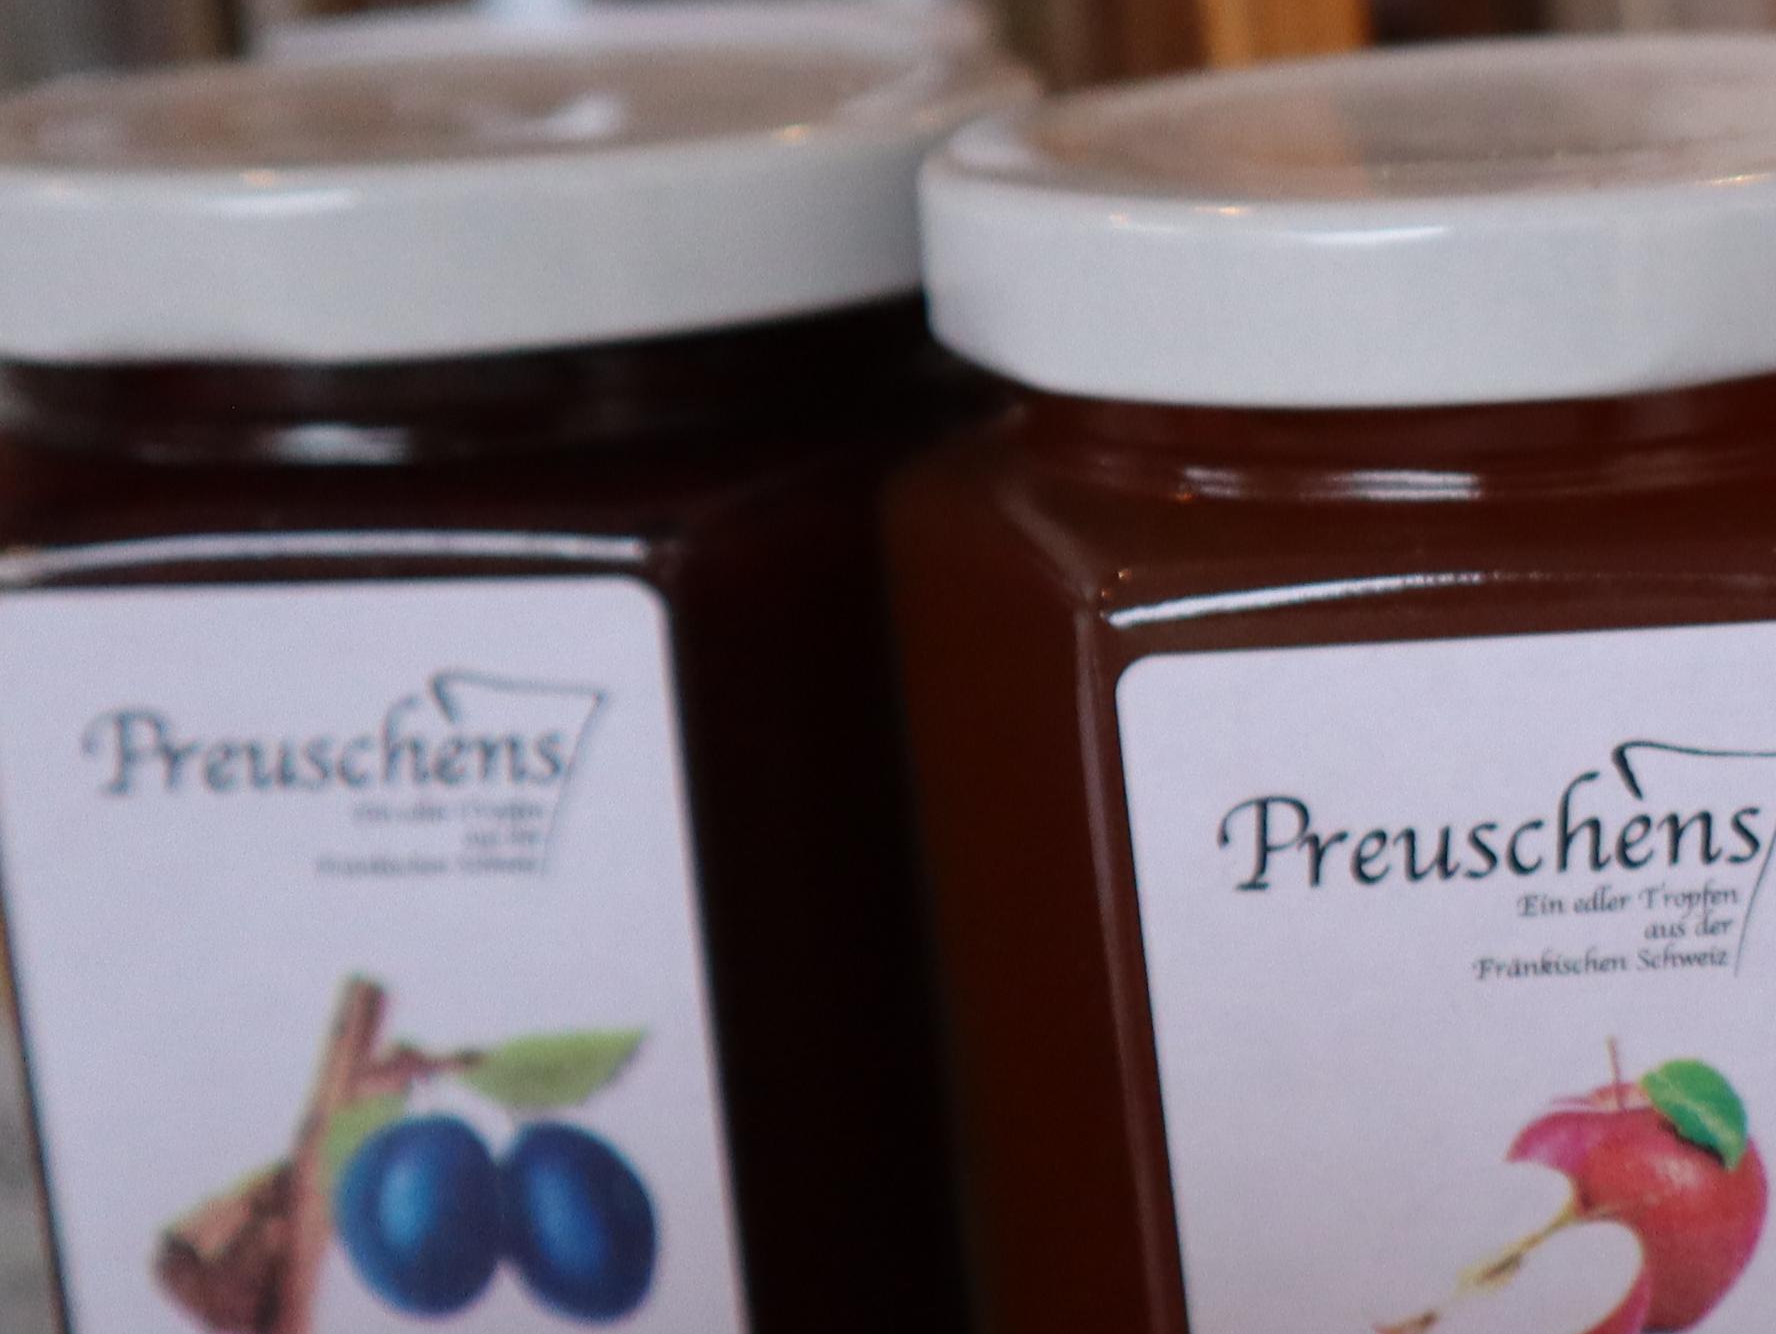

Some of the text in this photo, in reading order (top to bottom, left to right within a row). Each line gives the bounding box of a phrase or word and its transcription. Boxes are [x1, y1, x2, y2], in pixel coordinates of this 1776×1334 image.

[78, 691, 568, 797] Preuschens
[1217, 770, 1763, 892] Preuschens
[1517, 879, 1739, 919] Ein edler Tropfen
[1644, 910, 1734, 940] aus der
[1473, 942, 1729, 980] Fränkischen Schweiz
